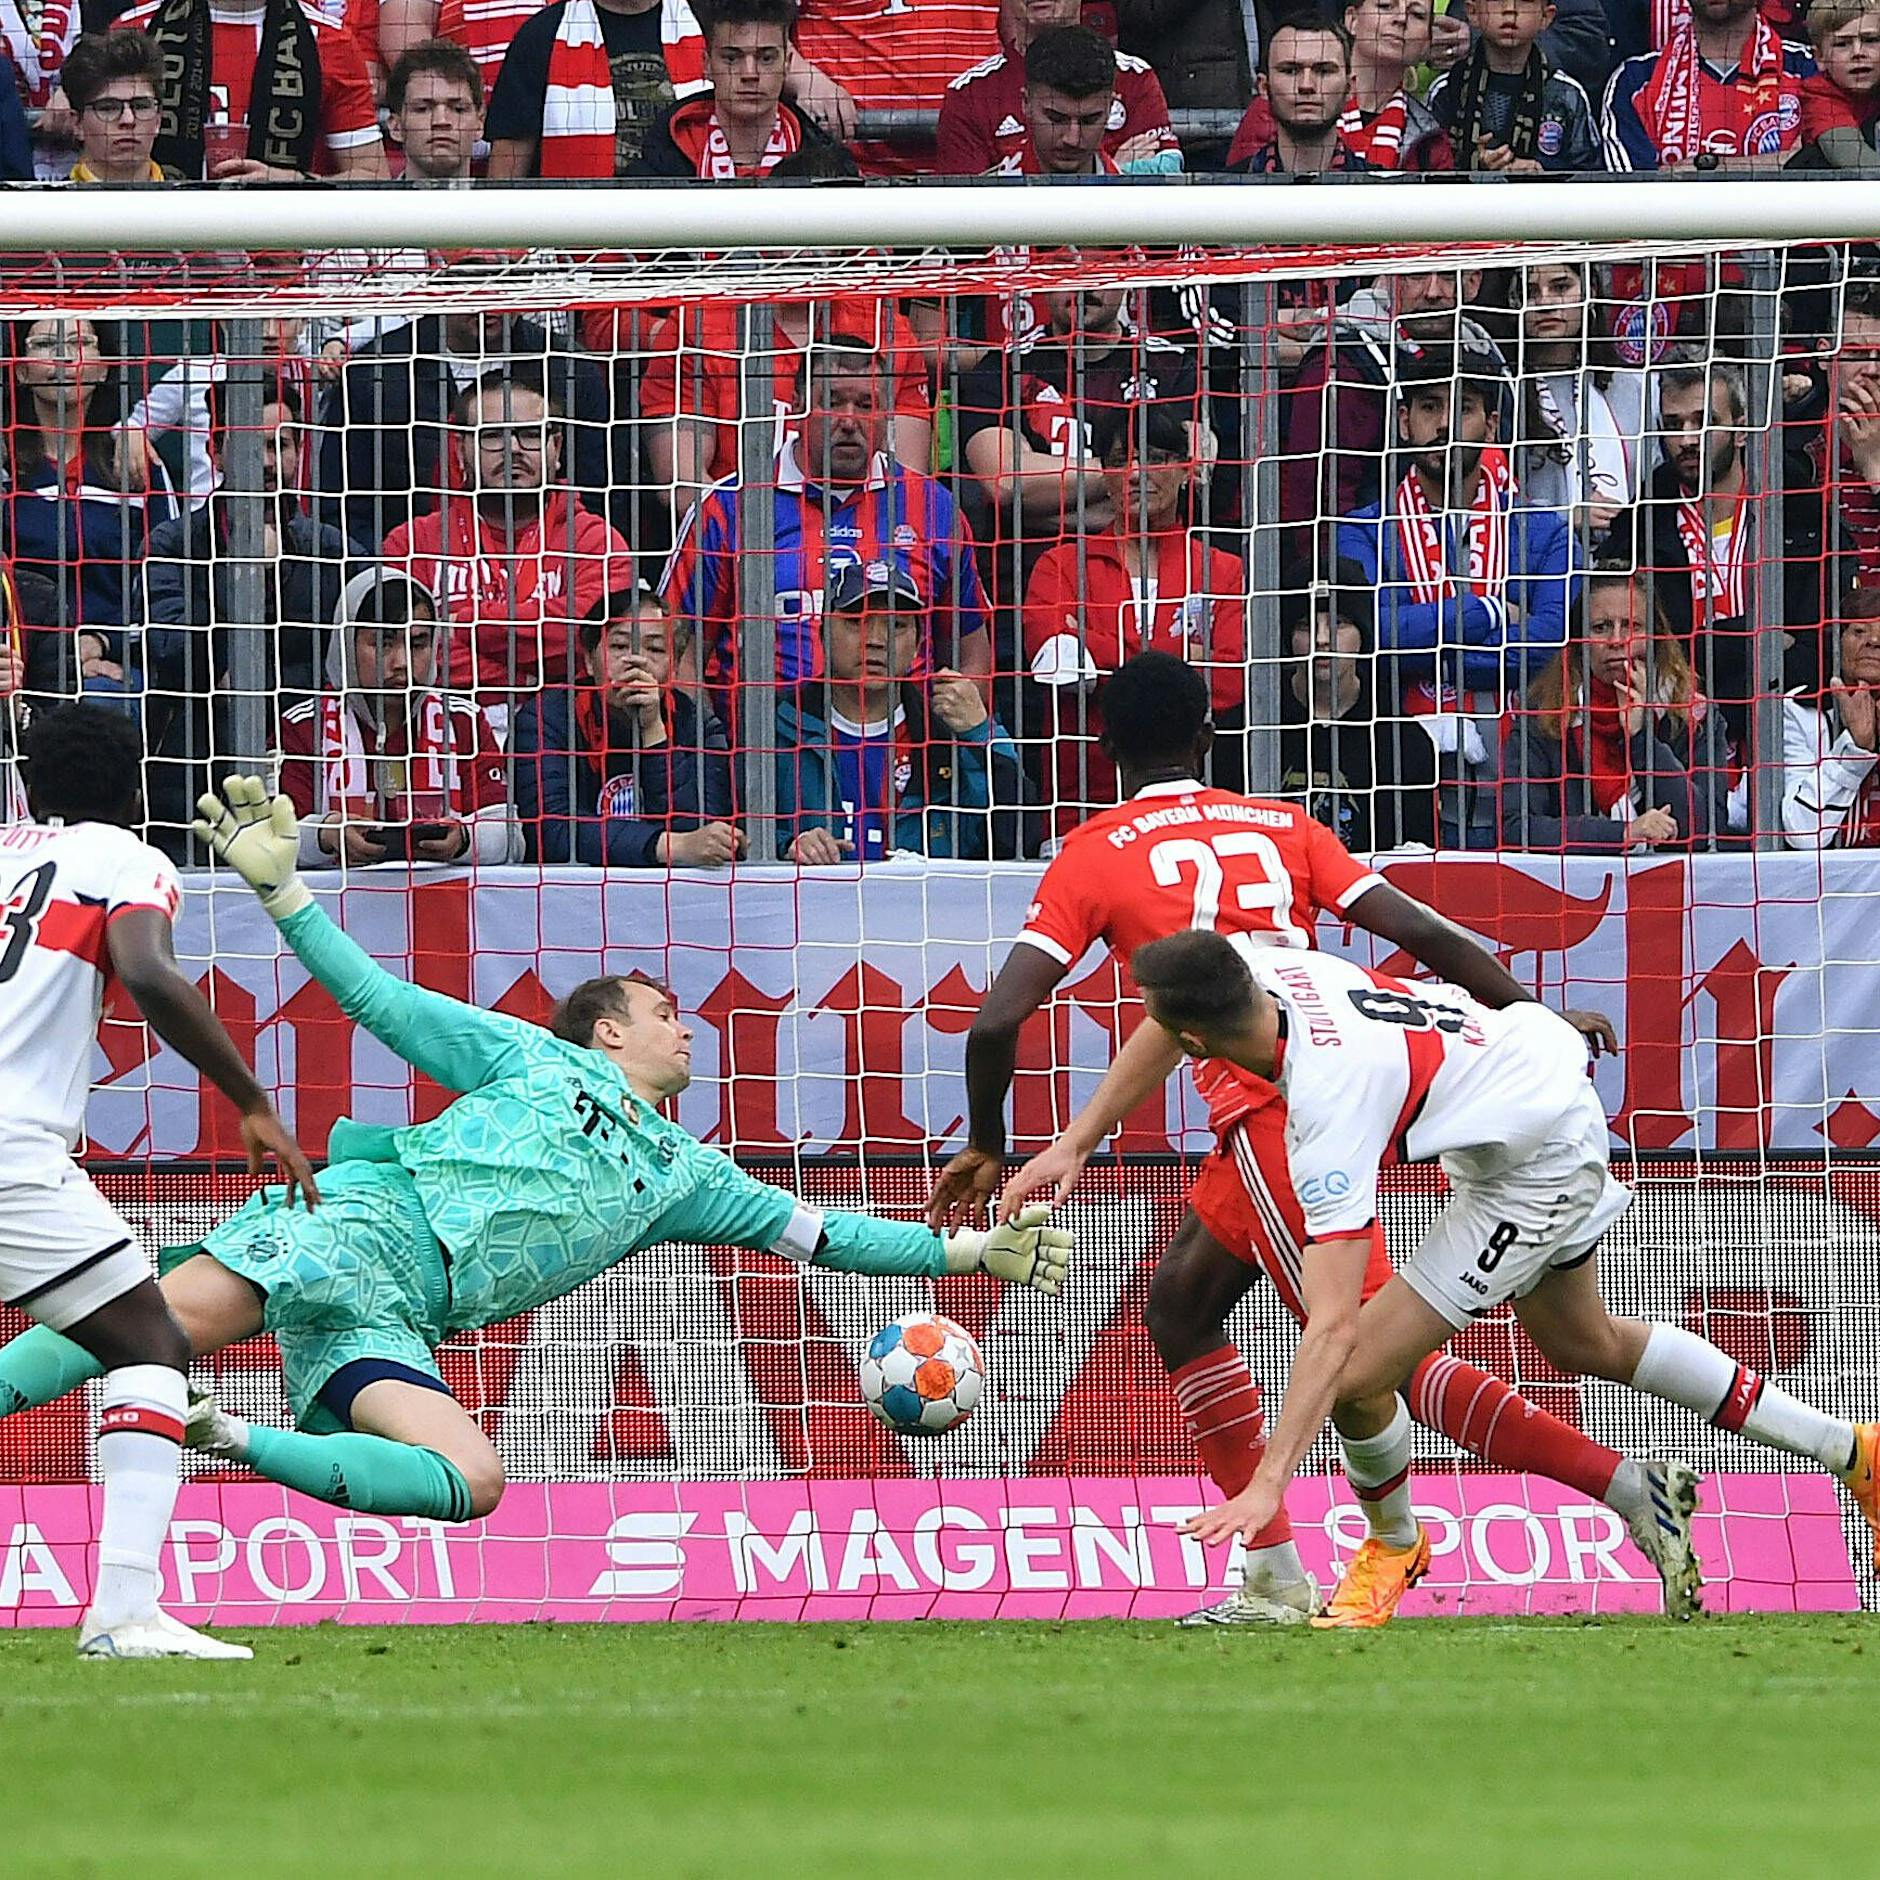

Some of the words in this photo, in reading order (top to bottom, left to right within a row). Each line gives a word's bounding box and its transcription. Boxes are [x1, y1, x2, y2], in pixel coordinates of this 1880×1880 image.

[264, 107, 303, 165] FC
[1107, 825, 1138, 849] FC
[1132, 805, 1204, 834] BAYERN
[1149, 831, 1310, 949] 23
[1274, 965, 1343, 1047] STUTTGART
[1477, 1221, 1519, 1274] 9
[1458, 1271, 1490, 1296] JAKO
[1735, 1367, 1758, 1411] JAK
[155, 1516, 471, 1604] PORT
